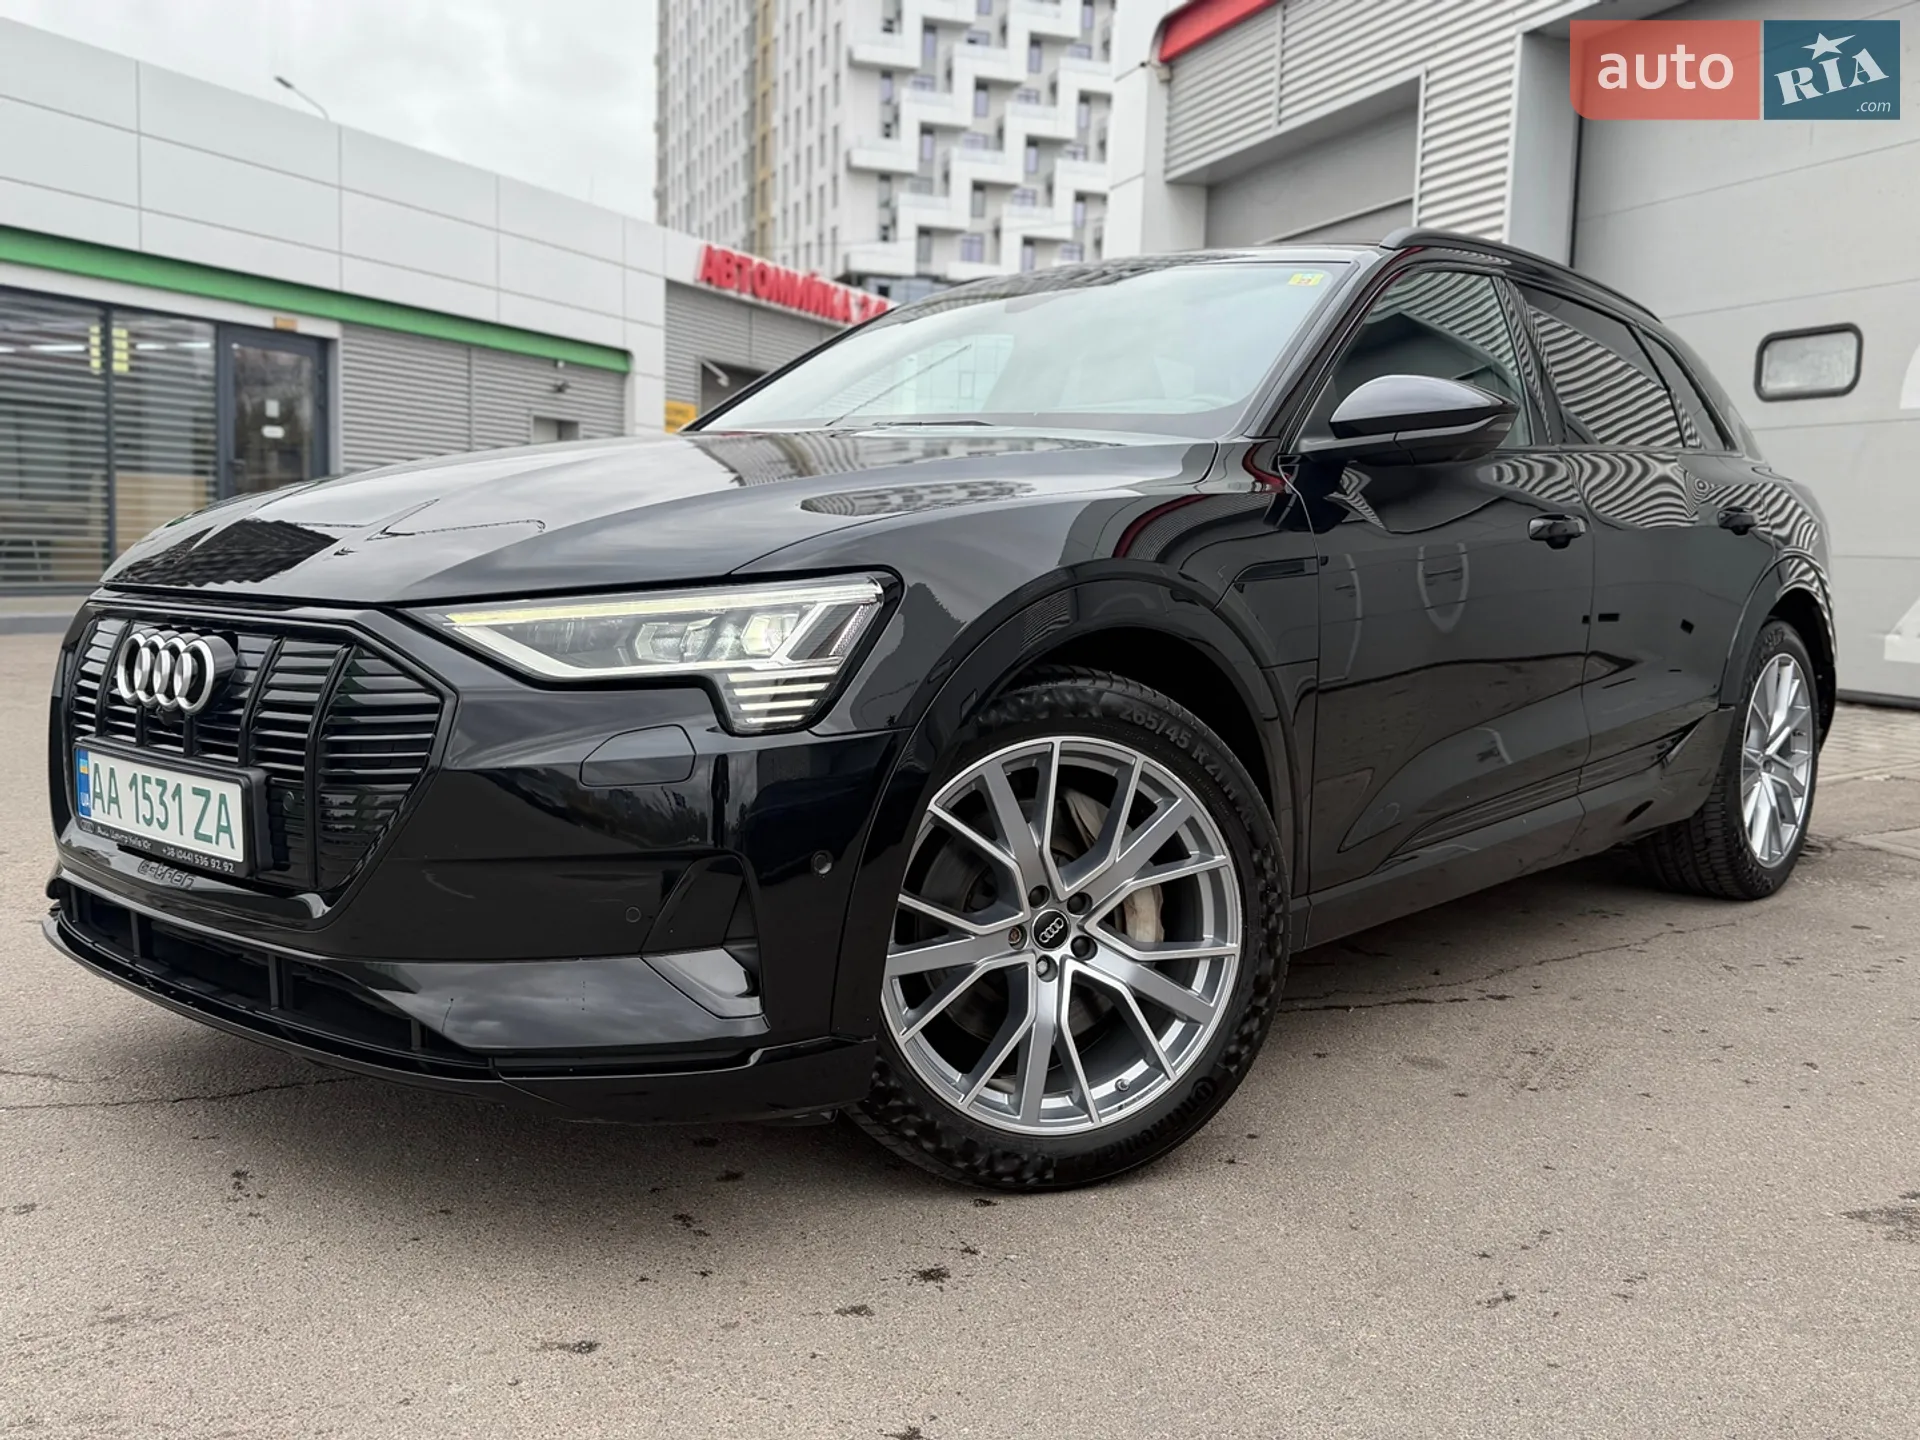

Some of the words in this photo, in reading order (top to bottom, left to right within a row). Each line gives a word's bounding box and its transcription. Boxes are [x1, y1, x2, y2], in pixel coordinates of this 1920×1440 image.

[92, 762, 122, 819] AA
[128, 772, 184, 836] 1531
[191, 786, 236, 850] ZA
